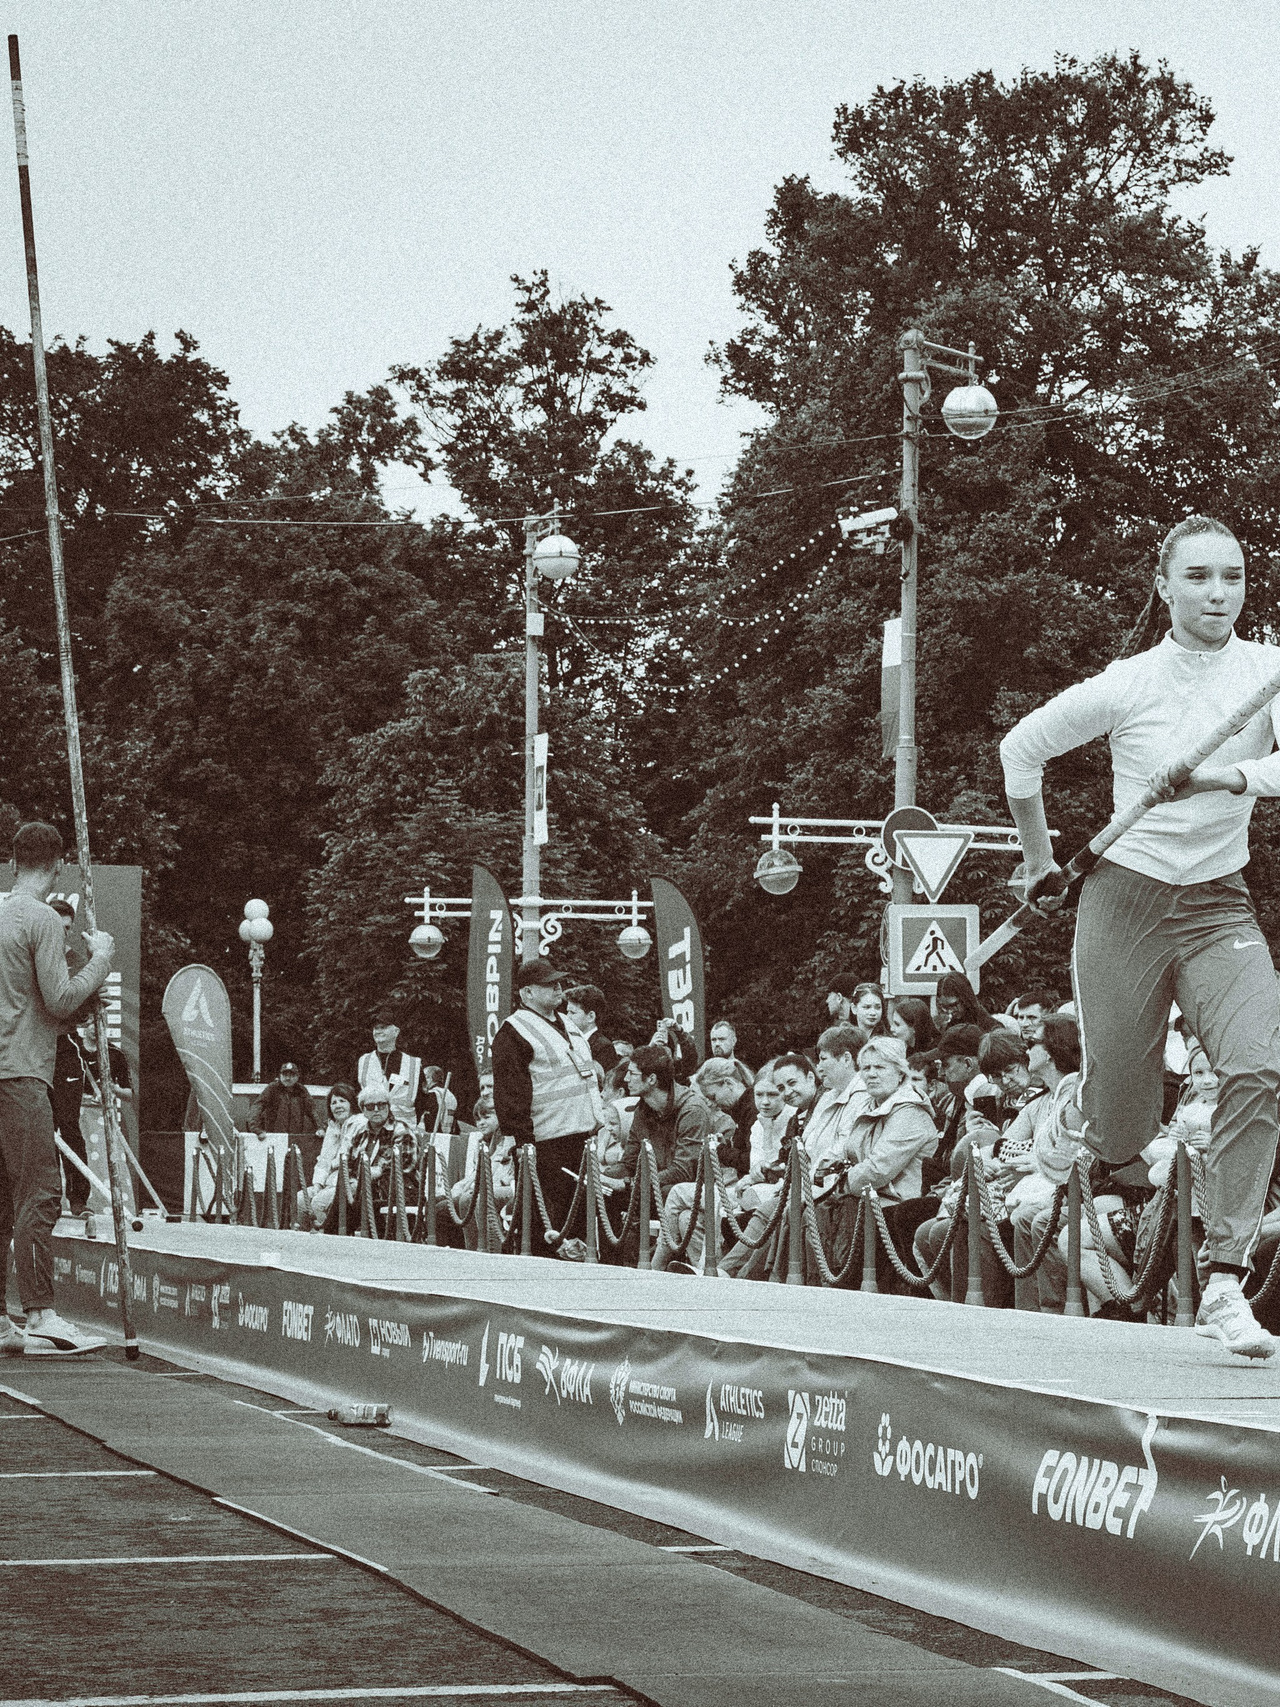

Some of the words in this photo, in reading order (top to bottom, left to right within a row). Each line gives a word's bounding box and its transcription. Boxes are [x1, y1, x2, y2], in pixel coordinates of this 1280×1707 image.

[282, 1301, 314, 1342] FONBET
[496, 1332, 525, 1383] ПСБ
[720, 1384, 765, 1419] ATHLETICS
[814, 1390, 846, 1431] zetta
[721, 1421, 744, 1442] LEAGUE
[811, 1436, 846, 1457] GROUP
[1032, 1449, 1158, 1539] FONBET
